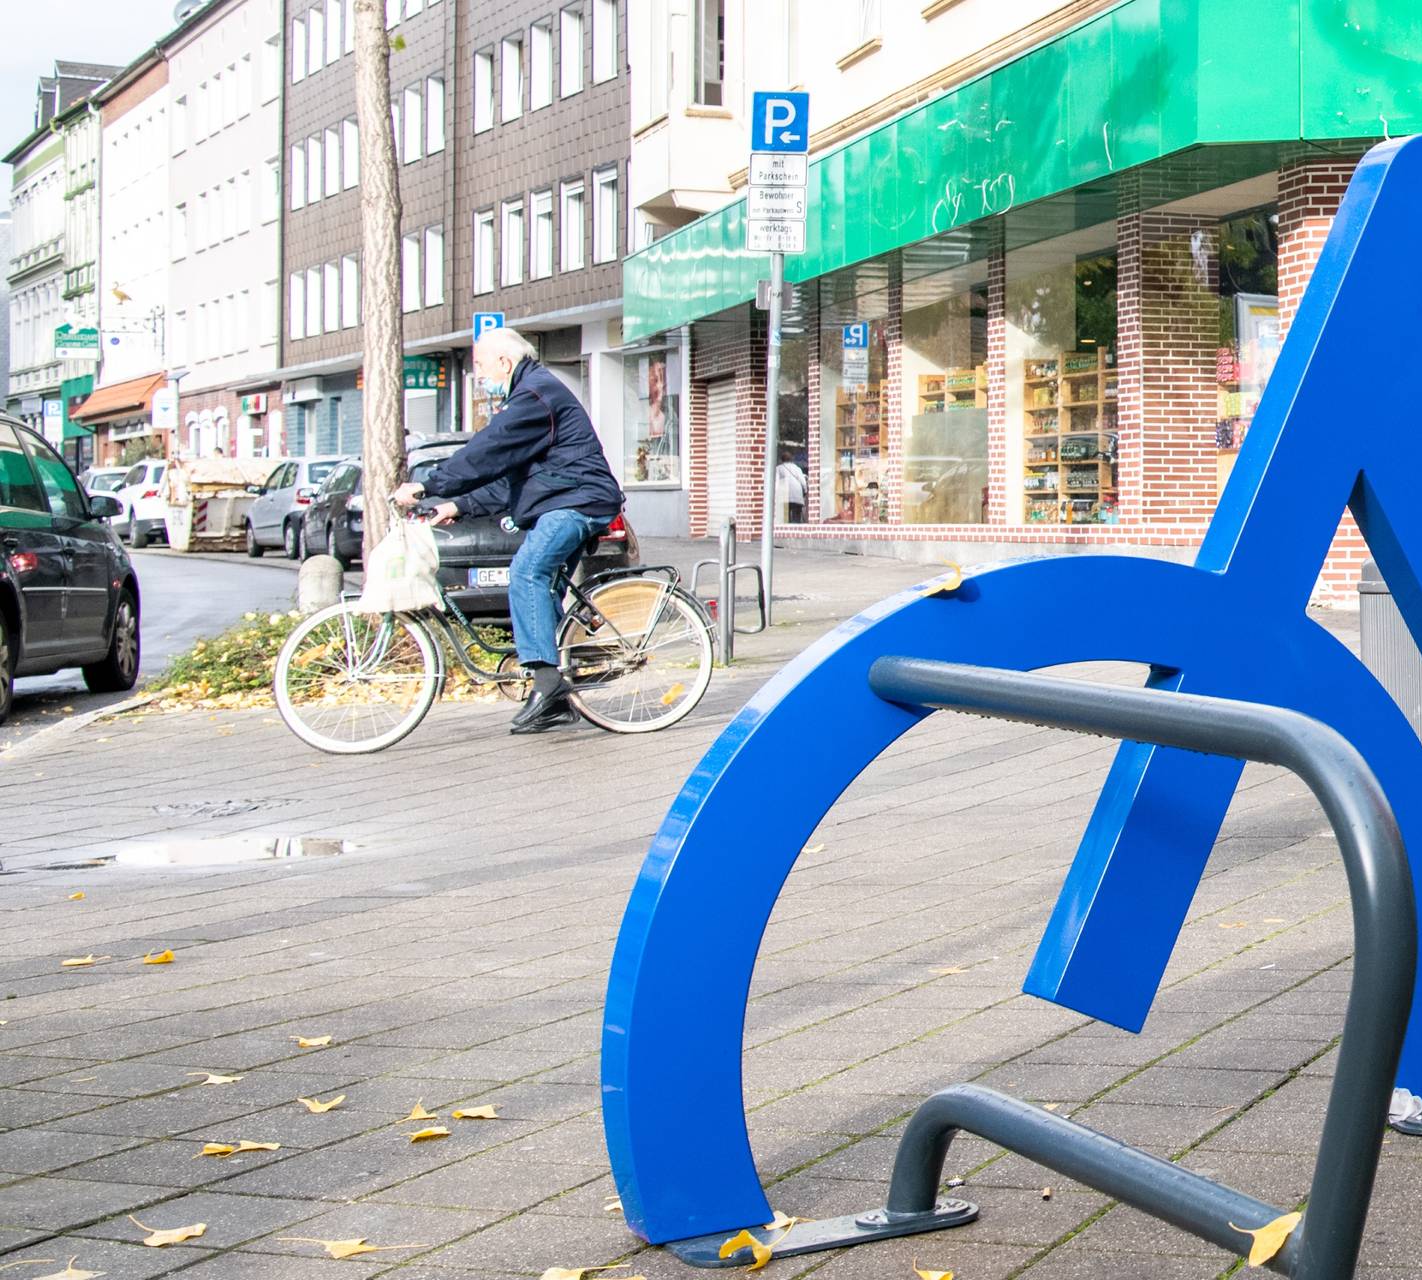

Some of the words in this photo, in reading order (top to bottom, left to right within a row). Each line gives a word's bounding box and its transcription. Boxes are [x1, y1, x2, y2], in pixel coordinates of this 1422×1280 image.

[764, 98, 796, 145] P
[772, 160, 784, 168] mit
[759, 171, 798, 181] Parkschein
[760, 190, 794, 200] Bewohner
[796, 200, 802, 214] S
[760, 223, 792, 235] werktags
[480, 315, 498, 337] P
[479, 570, 496, 582] GE
